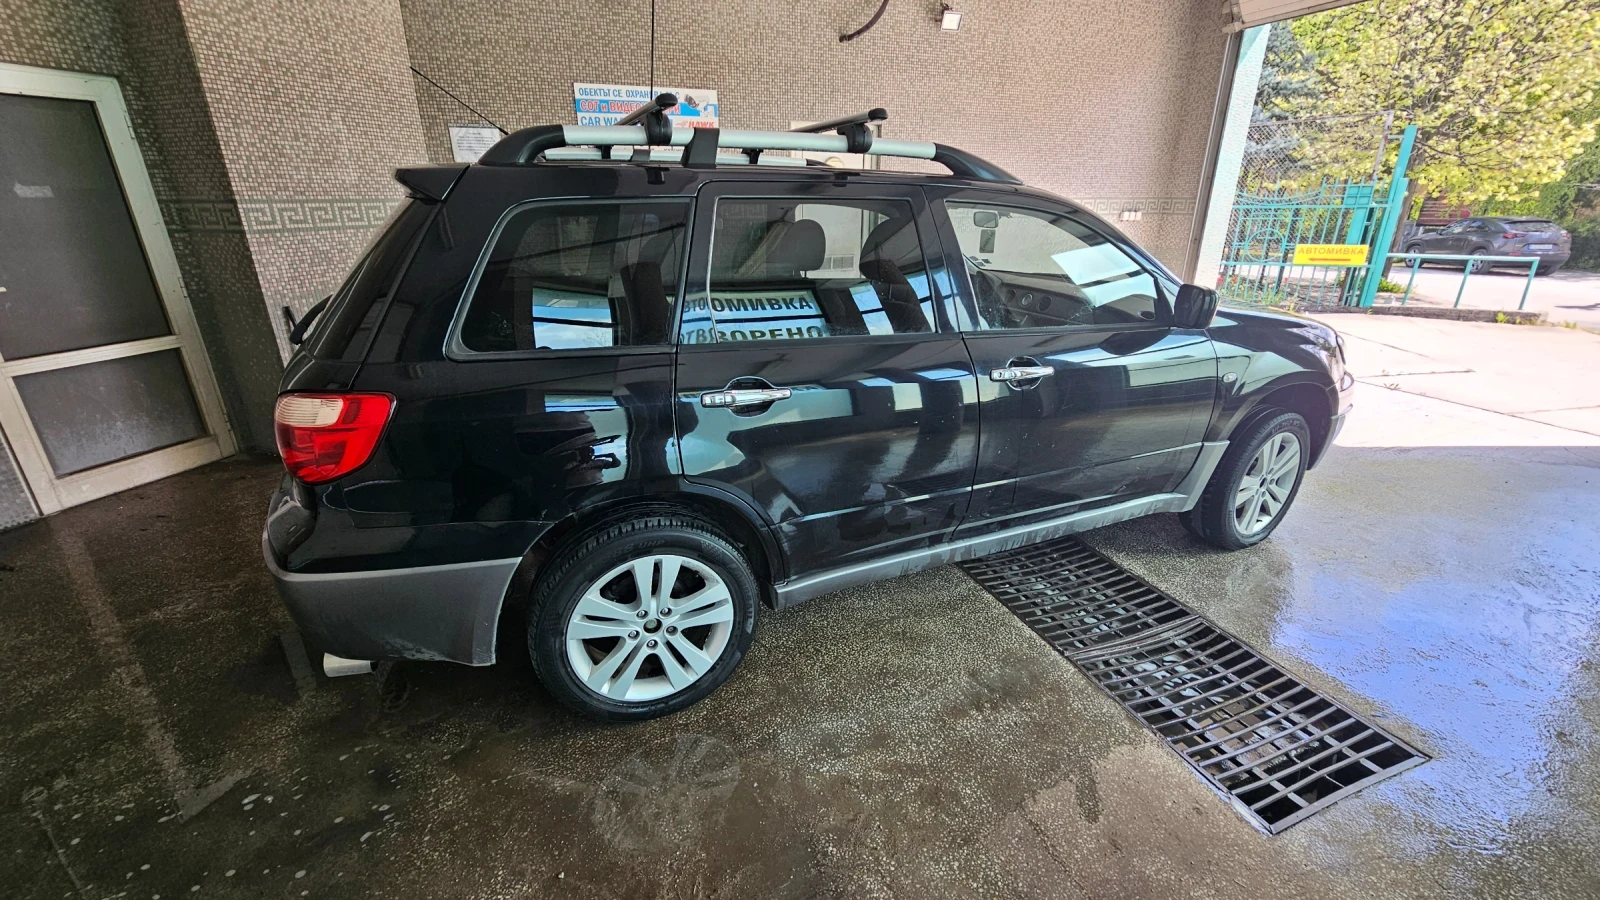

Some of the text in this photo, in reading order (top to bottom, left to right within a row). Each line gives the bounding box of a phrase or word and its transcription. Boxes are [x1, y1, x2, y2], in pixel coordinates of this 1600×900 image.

[579, 88, 611, 97] ОБЕКТЪТ
[613, 89, 623, 98] СЕ
[580, 100, 599, 111] СОТ
[580, 115, 601, 126] CAR
[688, 120, 715, 128] HAWK
[1298, 247, 1364, 255] АВТОМИВКА
